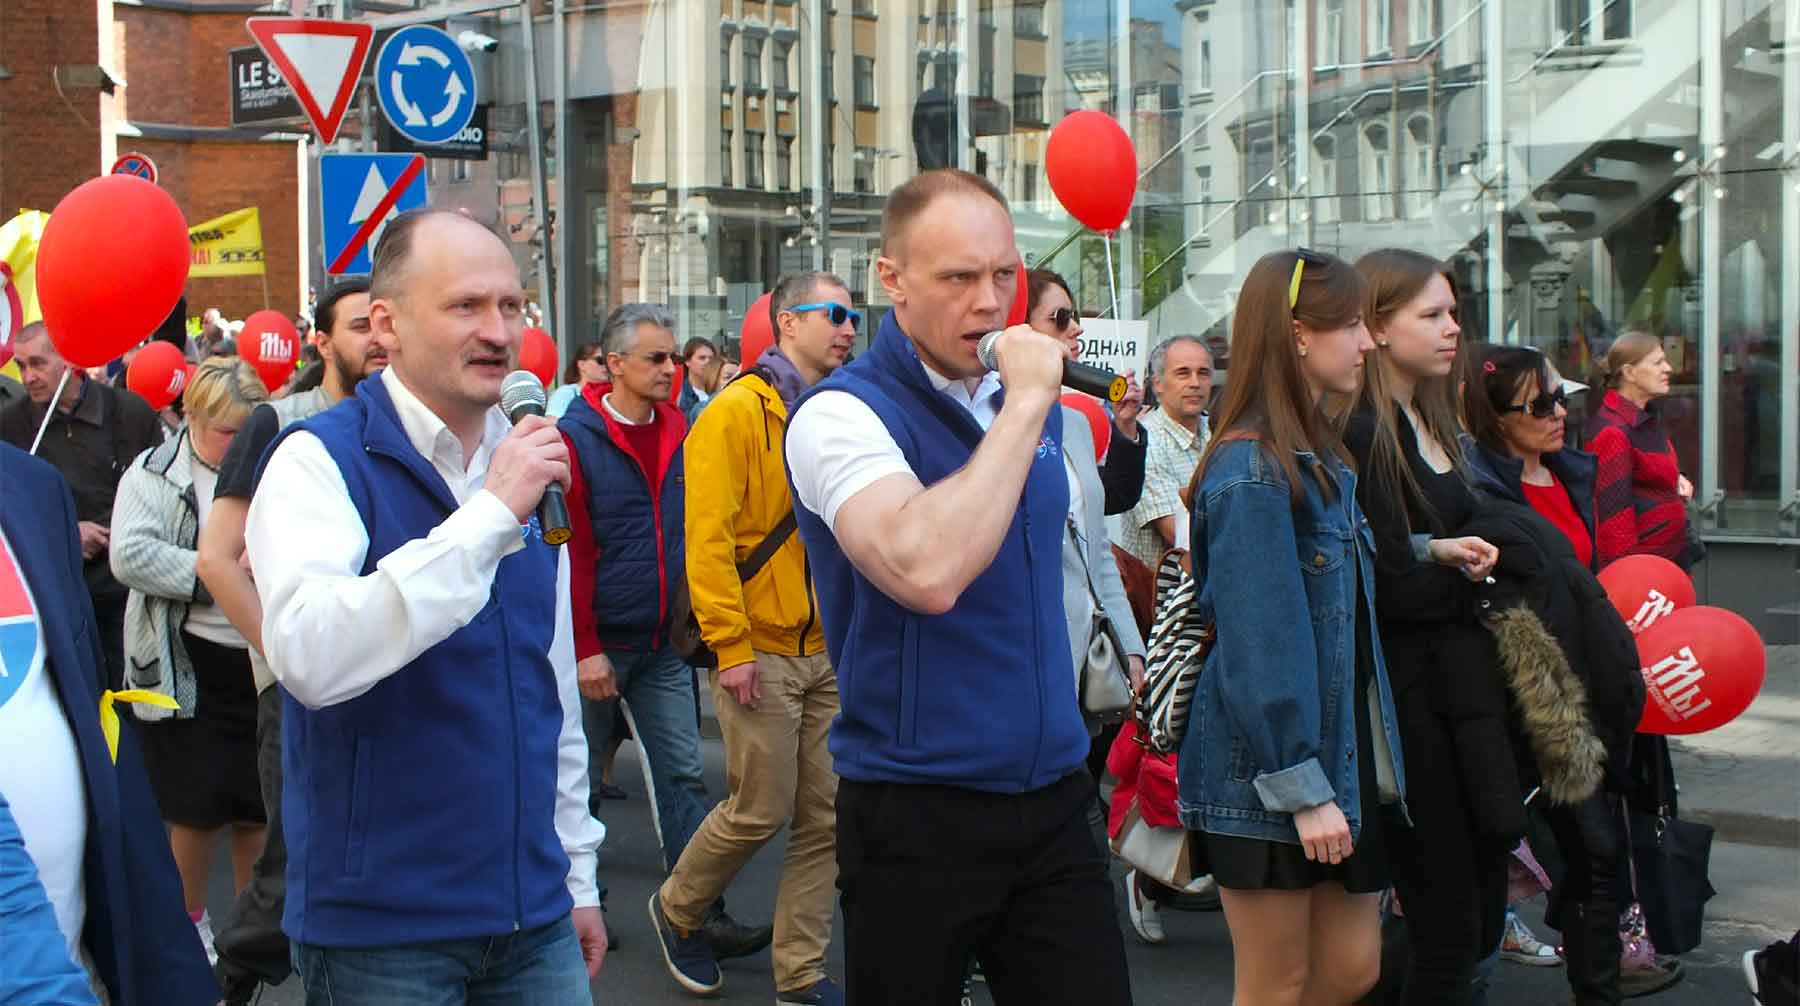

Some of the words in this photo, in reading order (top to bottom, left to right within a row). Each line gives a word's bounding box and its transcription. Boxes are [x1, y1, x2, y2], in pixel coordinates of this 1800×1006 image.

[239, 62, 263, 88] LE
[267, 62, 281, 85] S
[456, 127, 483, 142] DIO
[1077, 338, 1136, 358] ОДНАЯ
[1634, 588, 1675, 628] М
[1650, 645, 1712, 721] Мы
